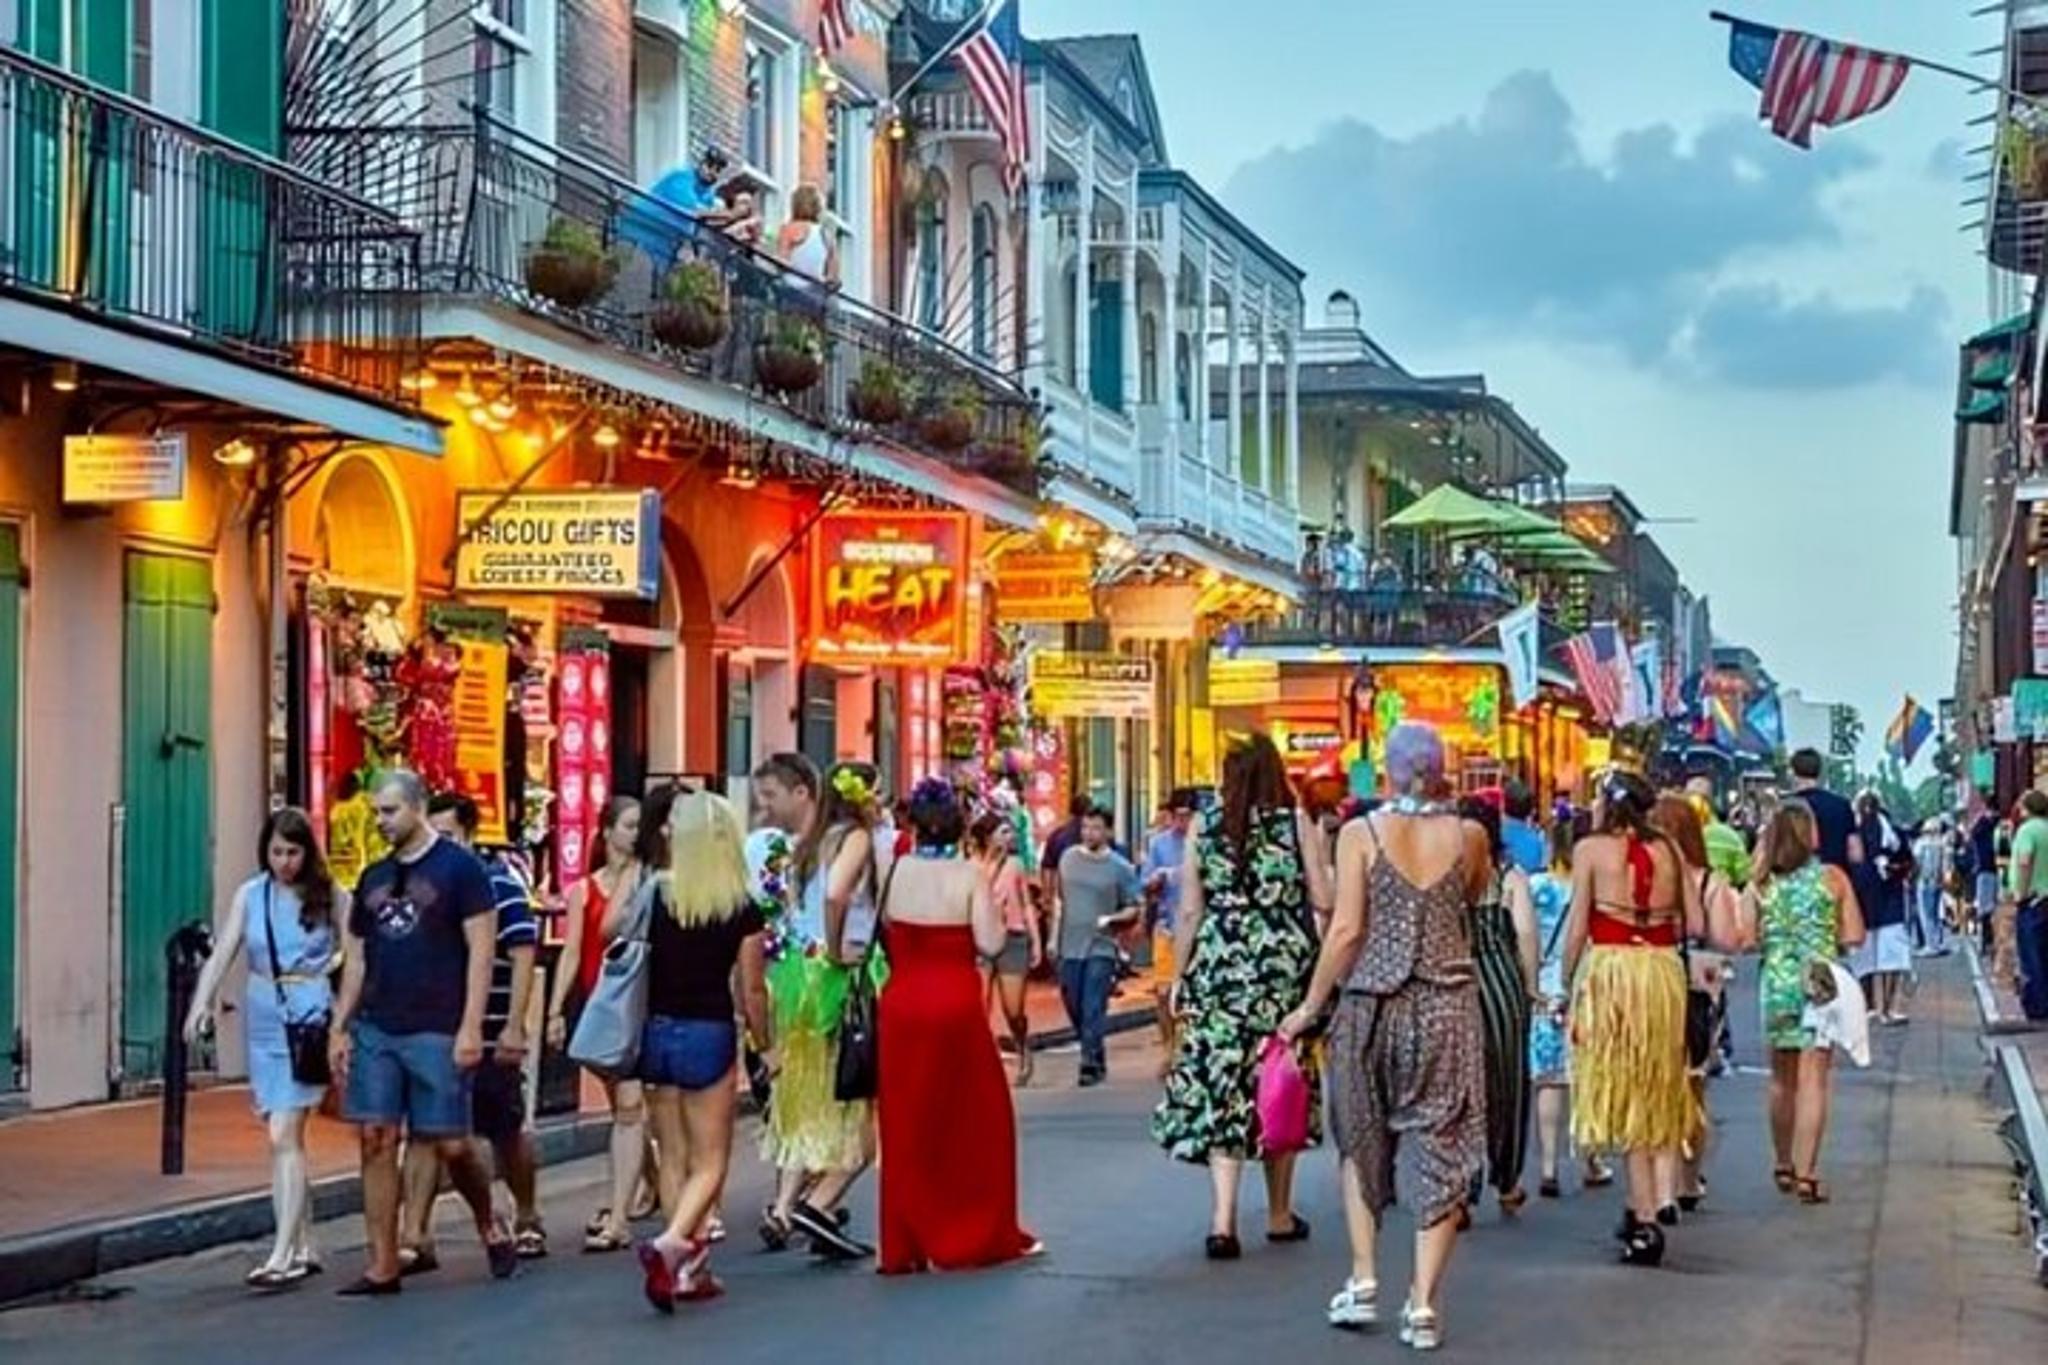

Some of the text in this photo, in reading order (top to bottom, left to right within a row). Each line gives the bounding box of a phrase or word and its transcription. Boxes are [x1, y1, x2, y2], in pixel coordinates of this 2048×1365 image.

[563, 517, 636, 546] GIFTS
[468, 567, 625, 586] LOWEST PRICES
[826, 565, 953, 612] HEAT
